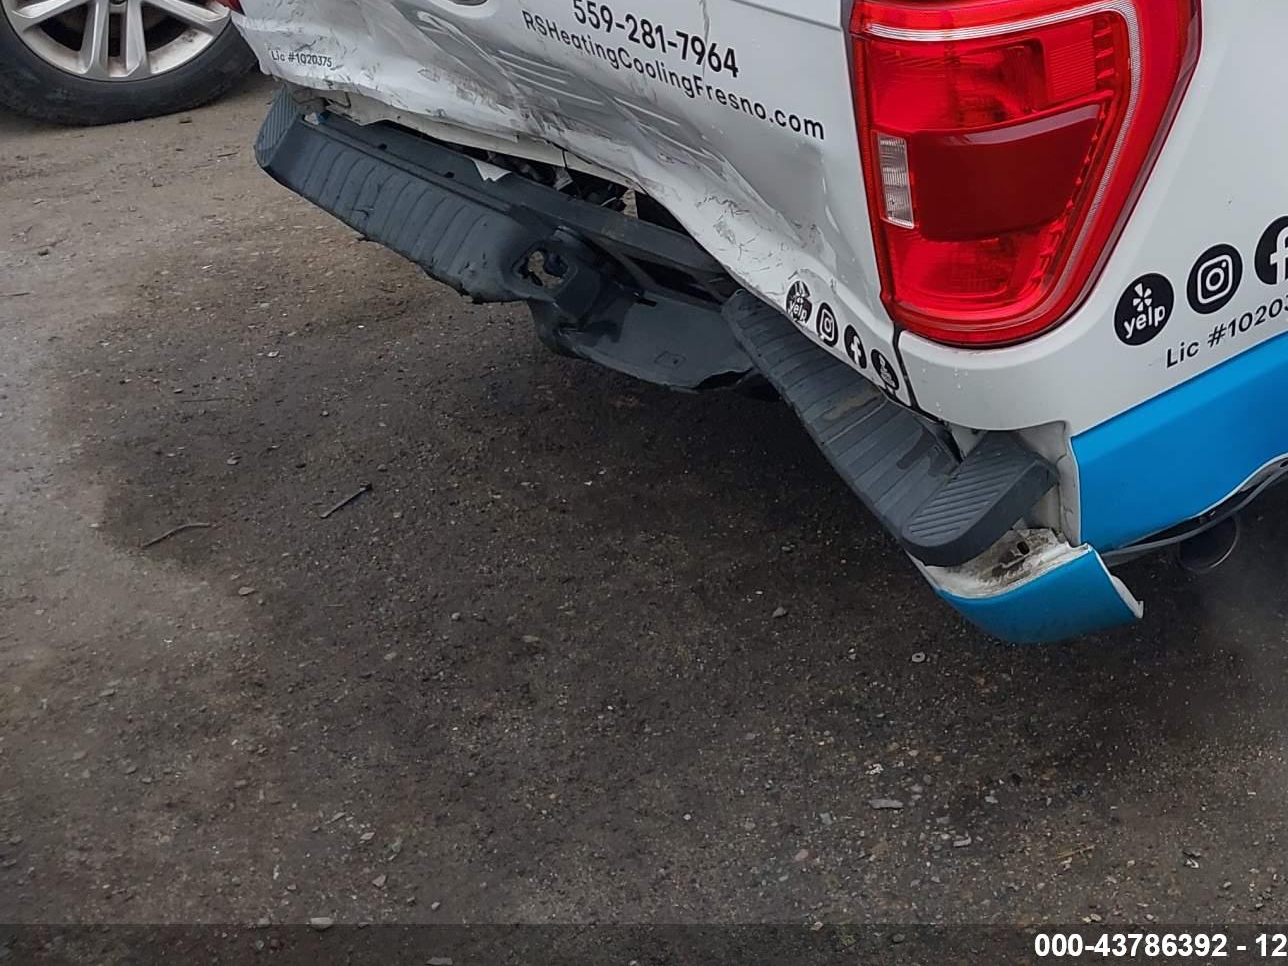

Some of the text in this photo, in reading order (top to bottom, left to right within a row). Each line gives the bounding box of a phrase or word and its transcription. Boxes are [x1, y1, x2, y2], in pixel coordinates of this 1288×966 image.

[288, 52, 333, 68] #1020375
[521, 9, 826, 140] RSHeatingCoolingFresno.com
[1123, 303, 1166, 340] yelp
[1166, 342, 1200, 369] Lic
